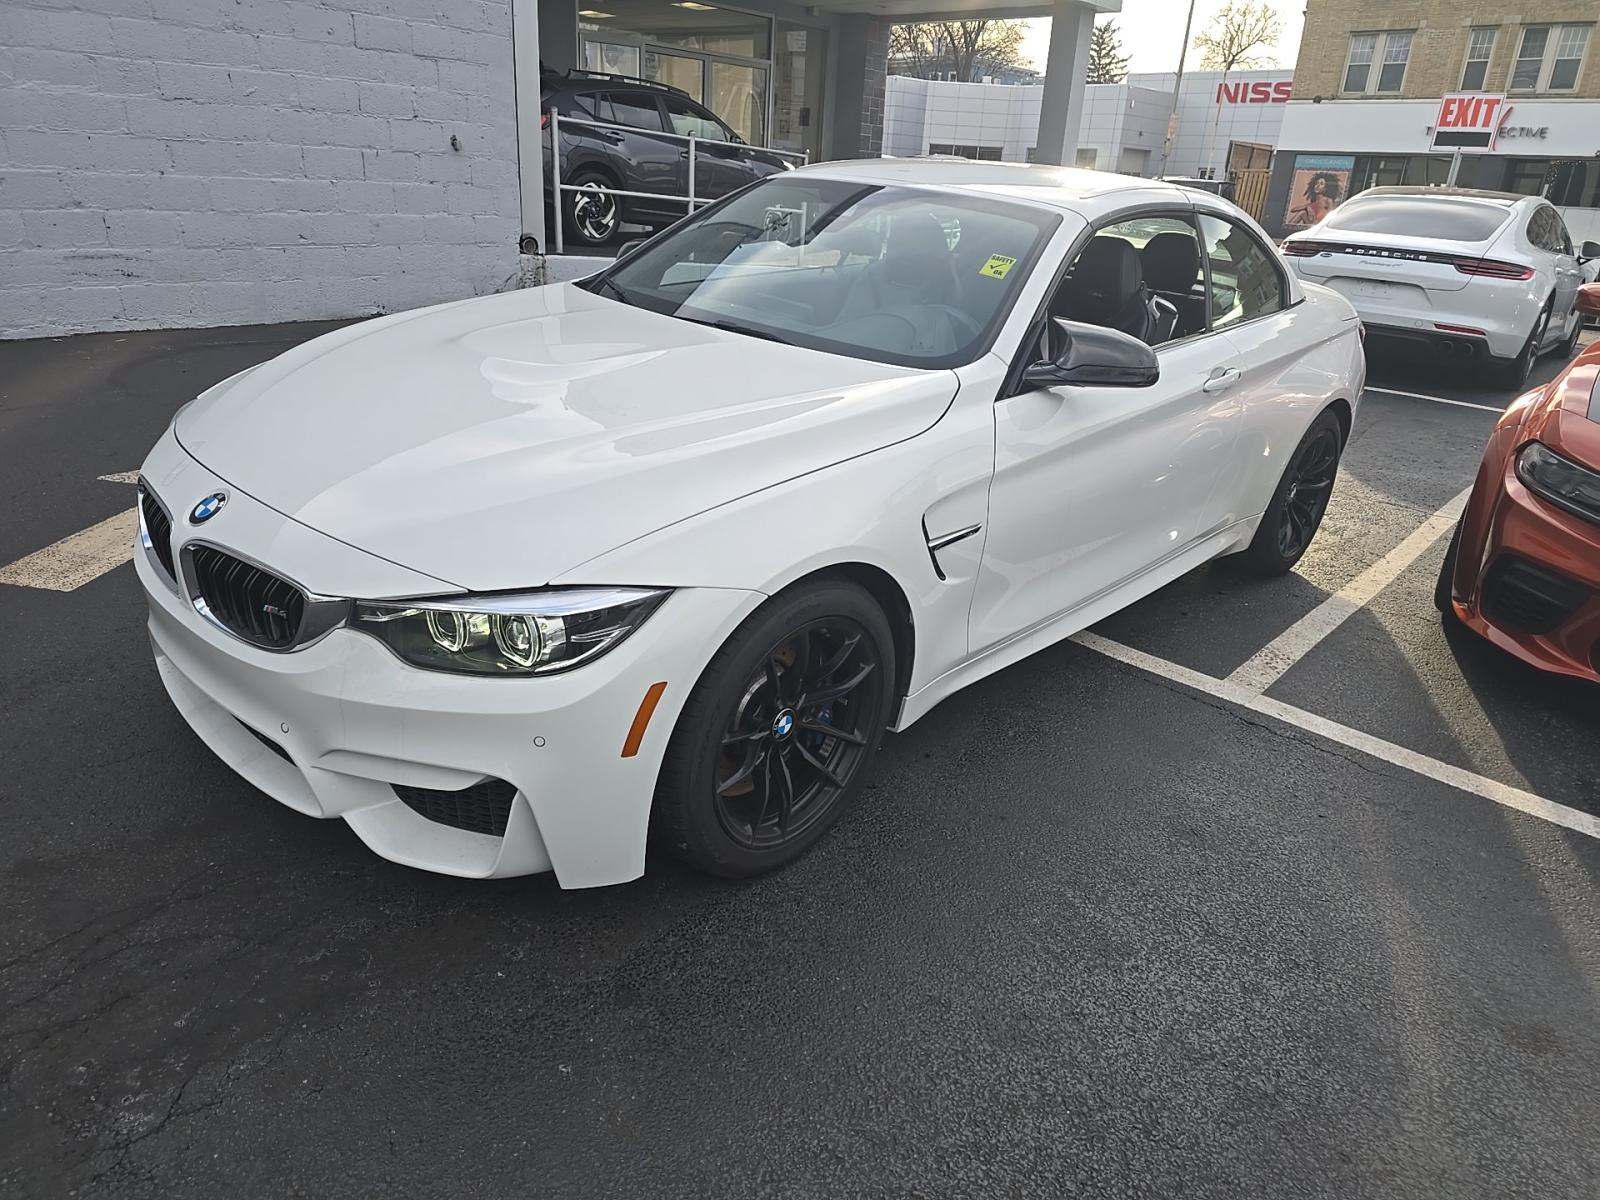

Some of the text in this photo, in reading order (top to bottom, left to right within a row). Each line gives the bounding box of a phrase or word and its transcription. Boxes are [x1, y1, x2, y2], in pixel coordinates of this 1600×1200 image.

[1216, 82, 1292, 103] NISS
[1438, 98, 1501, 128] EXIT
[1497, 127, 1549, 139] ECTIVE
[991, 255, 1014, 265] SAFETY
[1345, 248, 1427, 260] PORSCHE
